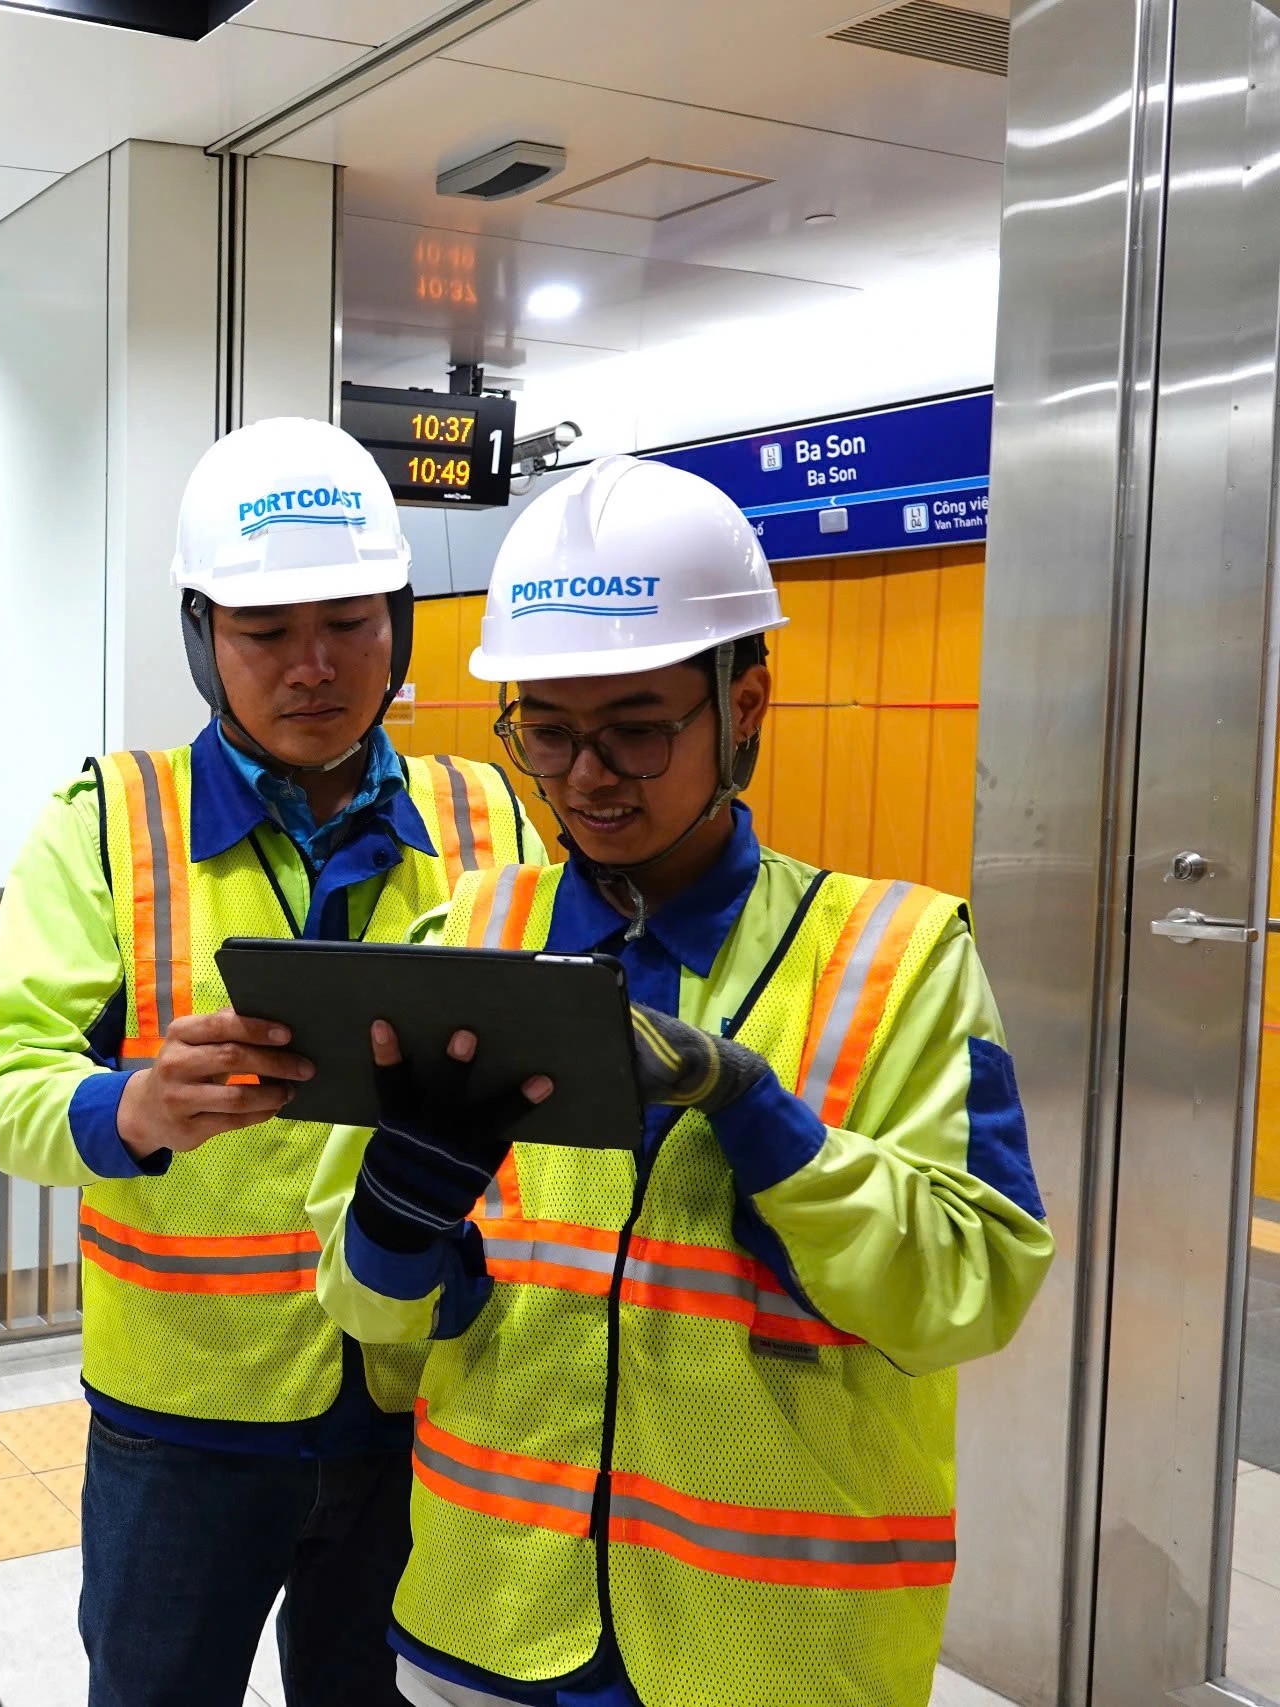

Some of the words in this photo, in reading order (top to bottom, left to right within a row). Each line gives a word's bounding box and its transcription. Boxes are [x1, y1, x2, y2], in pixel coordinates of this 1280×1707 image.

[412, 413, 474, 443] 10:37
[489, 429, 503, 475] 1
[795, 440, 821, 464] Ba
[826, 435, 866, 458] Son
[408, 456, 470, 486] 10:49
[807, 469, 826, 486] Ba
[829, 466, 857, 483] Son
[239, 487, 362, 521] PORTCOAST
[933, 500, 967, 516] Công
[934, 519, 952, 530] Van
[953, 515, 983, 528] Thanh
[511, 576, 660, 603] PORTCOAST
